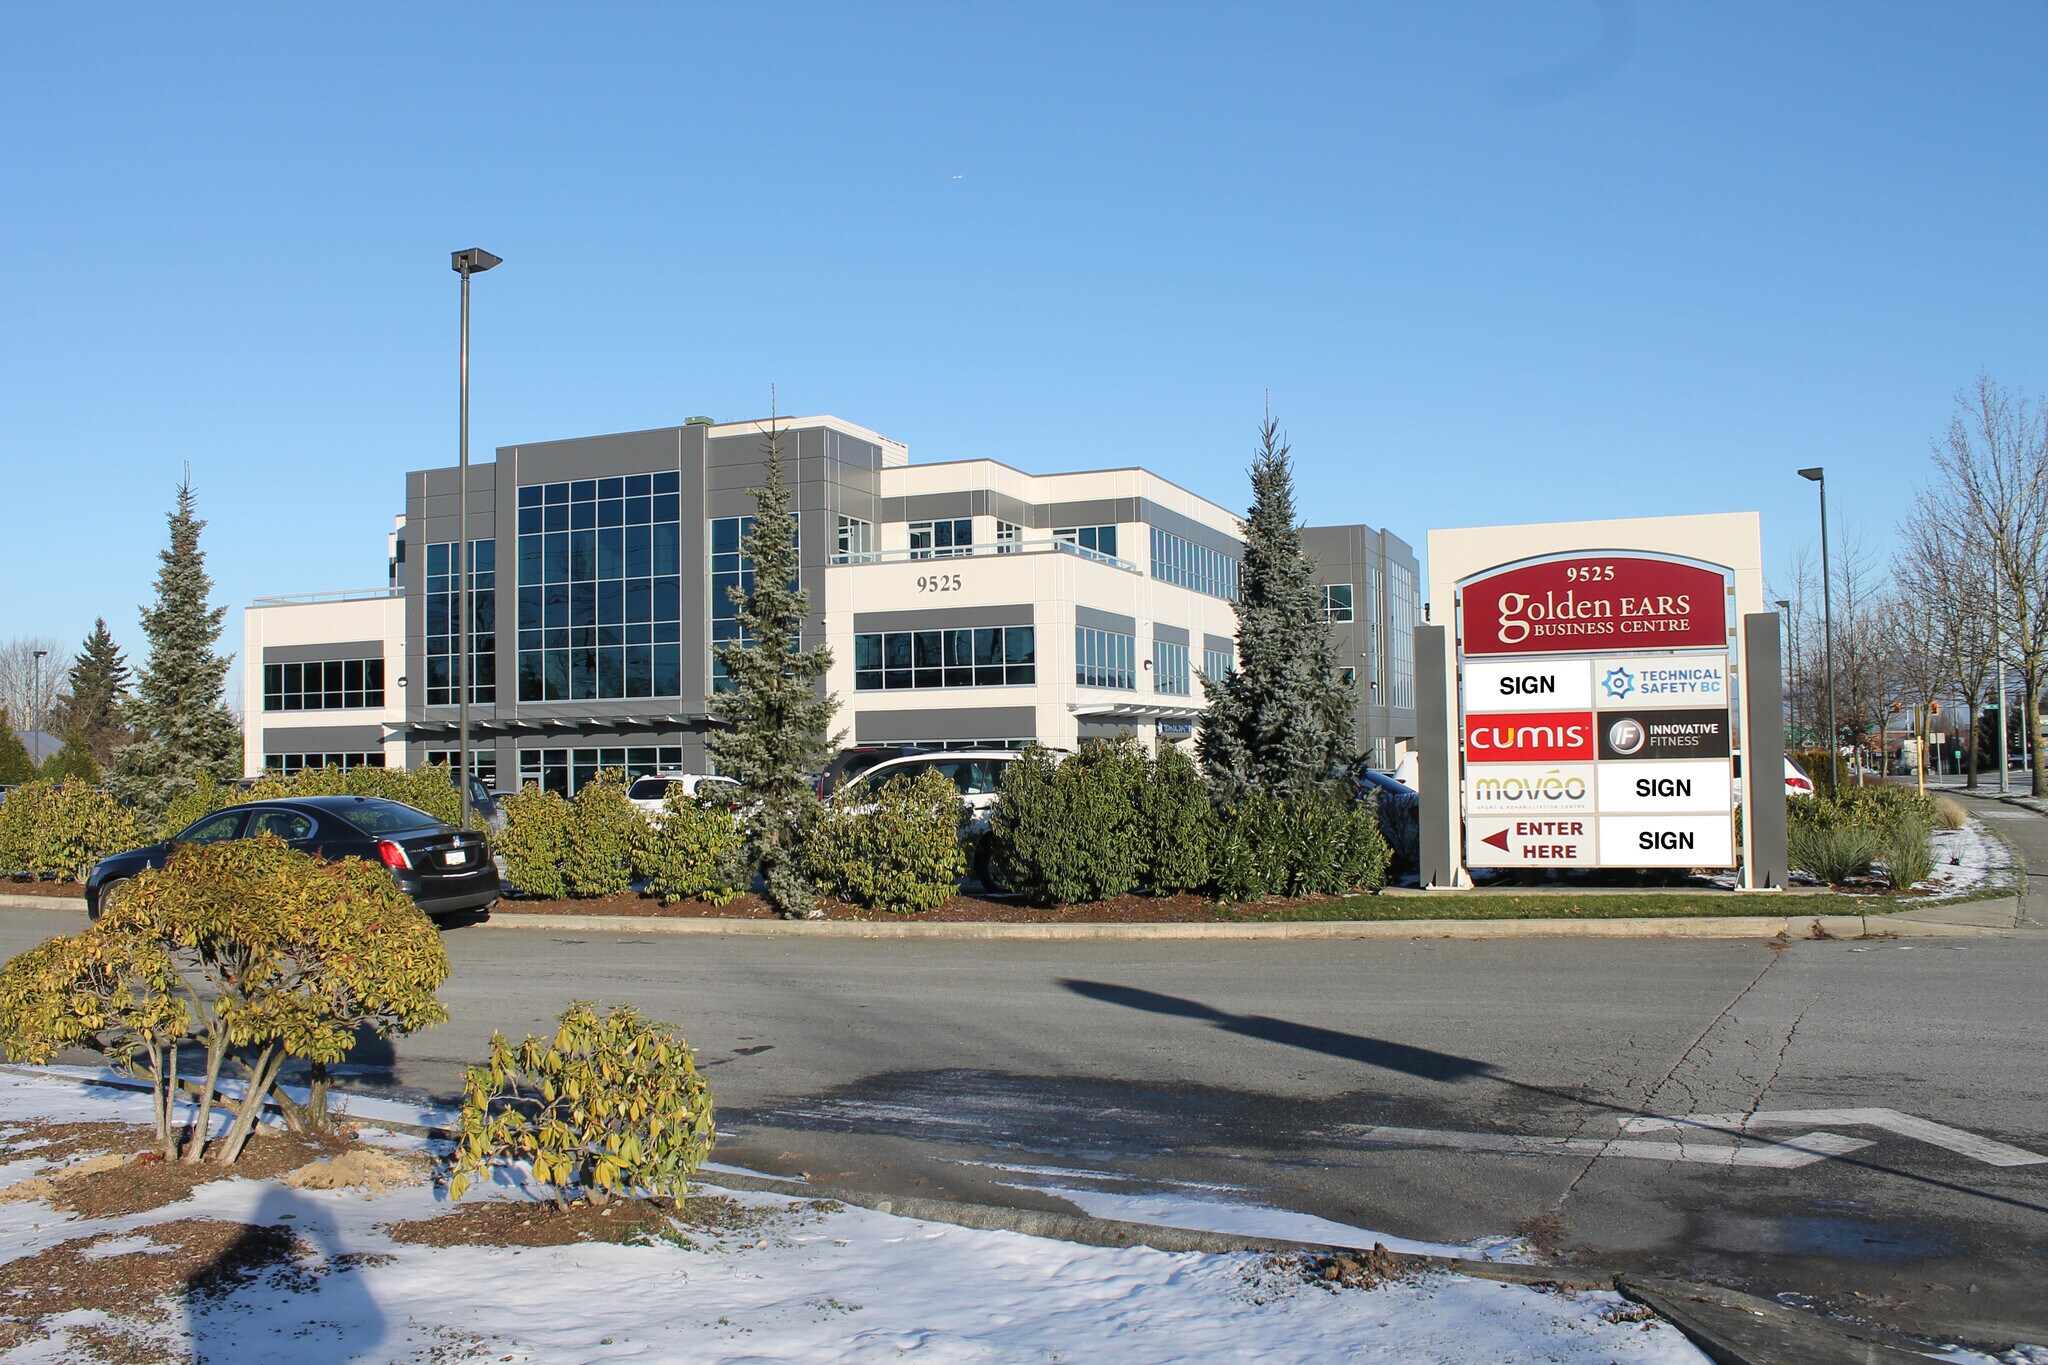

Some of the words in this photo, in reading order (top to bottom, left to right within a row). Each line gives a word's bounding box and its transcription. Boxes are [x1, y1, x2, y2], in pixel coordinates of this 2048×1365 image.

[1566, 565, 1615, 583] 9525
[916, 574, 962, 594] 9525
[1497, 589, 1613, 644] golden
[1619, 594, 1691, 617] EARS
[1533, 621, 1615, 637] BUSINESS
[1620, 618, 1691, 634] CENTRE
[1641, 668, 1721, 681] TECHNICAL
[1500, 675, 1555, 695] SIGN
[1641, 681, 1697, 694] SAFETY
[1700, 681, 1720, 693] BC
[1615, 726, 1636, 745] IF
[1649, 723, 1719, 735] INNOVATIVE
[1650, 736, 1699, 747] FITNESS
[1636, 779, 1691, 797] SIGN
[1516, 821, 1584, 836] ENTER
[1639, 831, 1694, 850] SIGN
[1523, 845, 1577, 859] HERE
